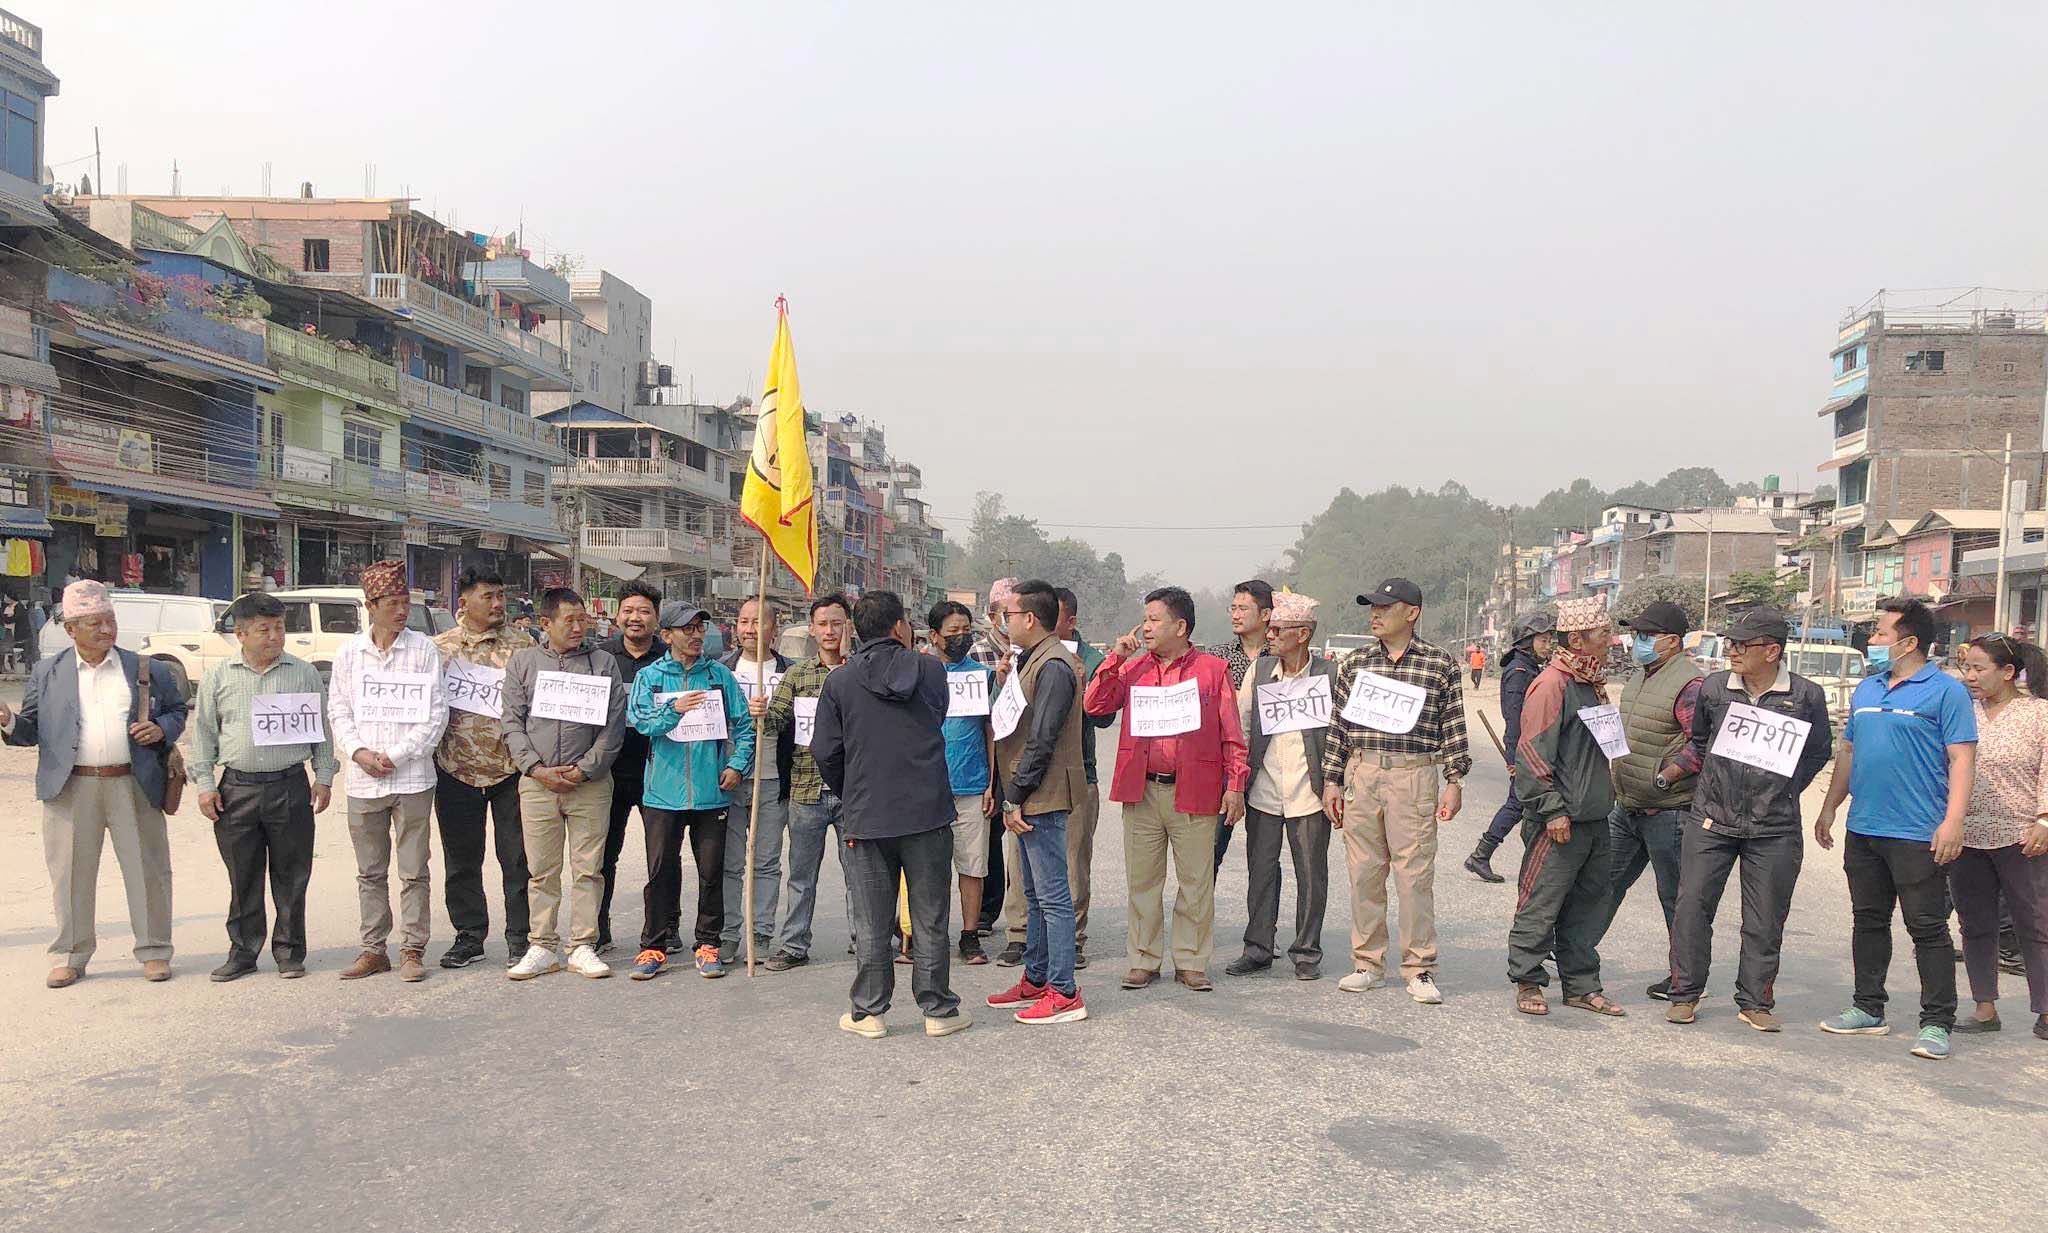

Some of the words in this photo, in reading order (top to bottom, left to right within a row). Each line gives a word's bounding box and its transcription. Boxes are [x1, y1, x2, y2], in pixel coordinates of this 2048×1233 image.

[362, 674, 426, 701] किरात
[1262, 687, 1328, 721] कोशी
[1356, 676, 1420, 714] किरात
[254, 703, 318, 734] कोशी
[1728, 710, 1803, 755] कोशी
